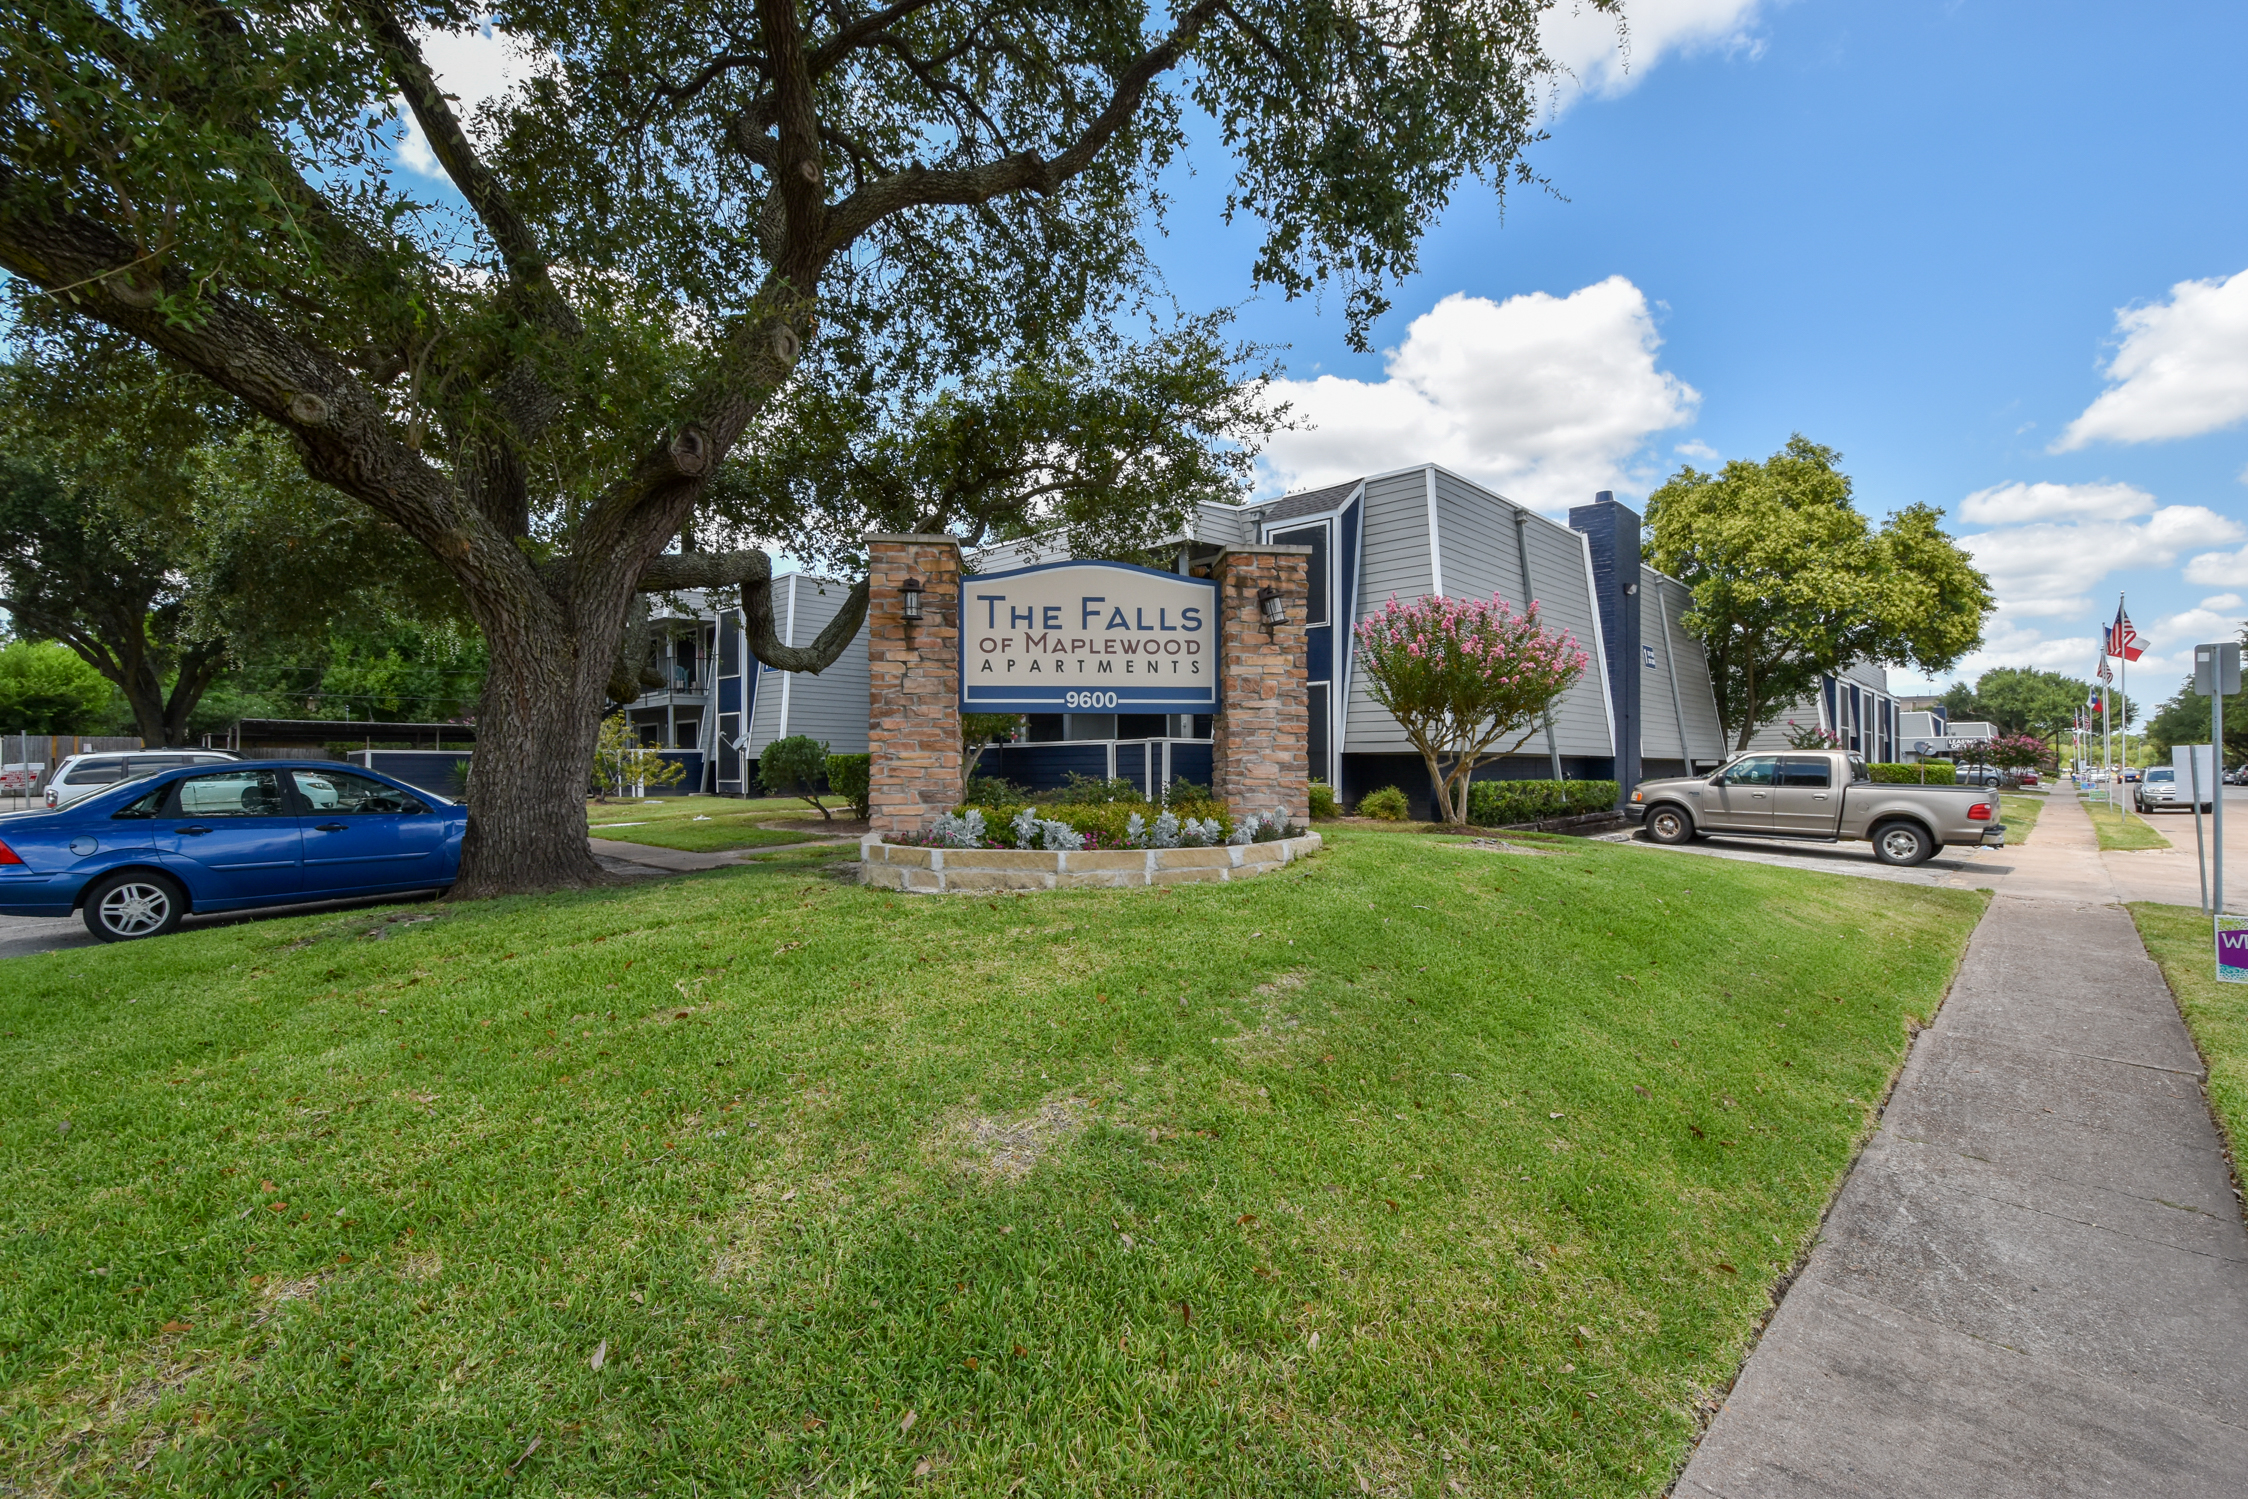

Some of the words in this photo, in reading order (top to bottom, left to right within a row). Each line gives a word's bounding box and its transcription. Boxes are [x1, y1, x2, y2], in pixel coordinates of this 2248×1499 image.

[977, 595, 1062, 630] THE
[1082, 597, 1202, 631] FALLS
[979, 637, 1013, 653] OF
[1024, 632, 1200, 655] MAPLEWOOD
[981, 659, 1200, 674] APARTMENTS
[1066, 691, 1117, 708] 9600
